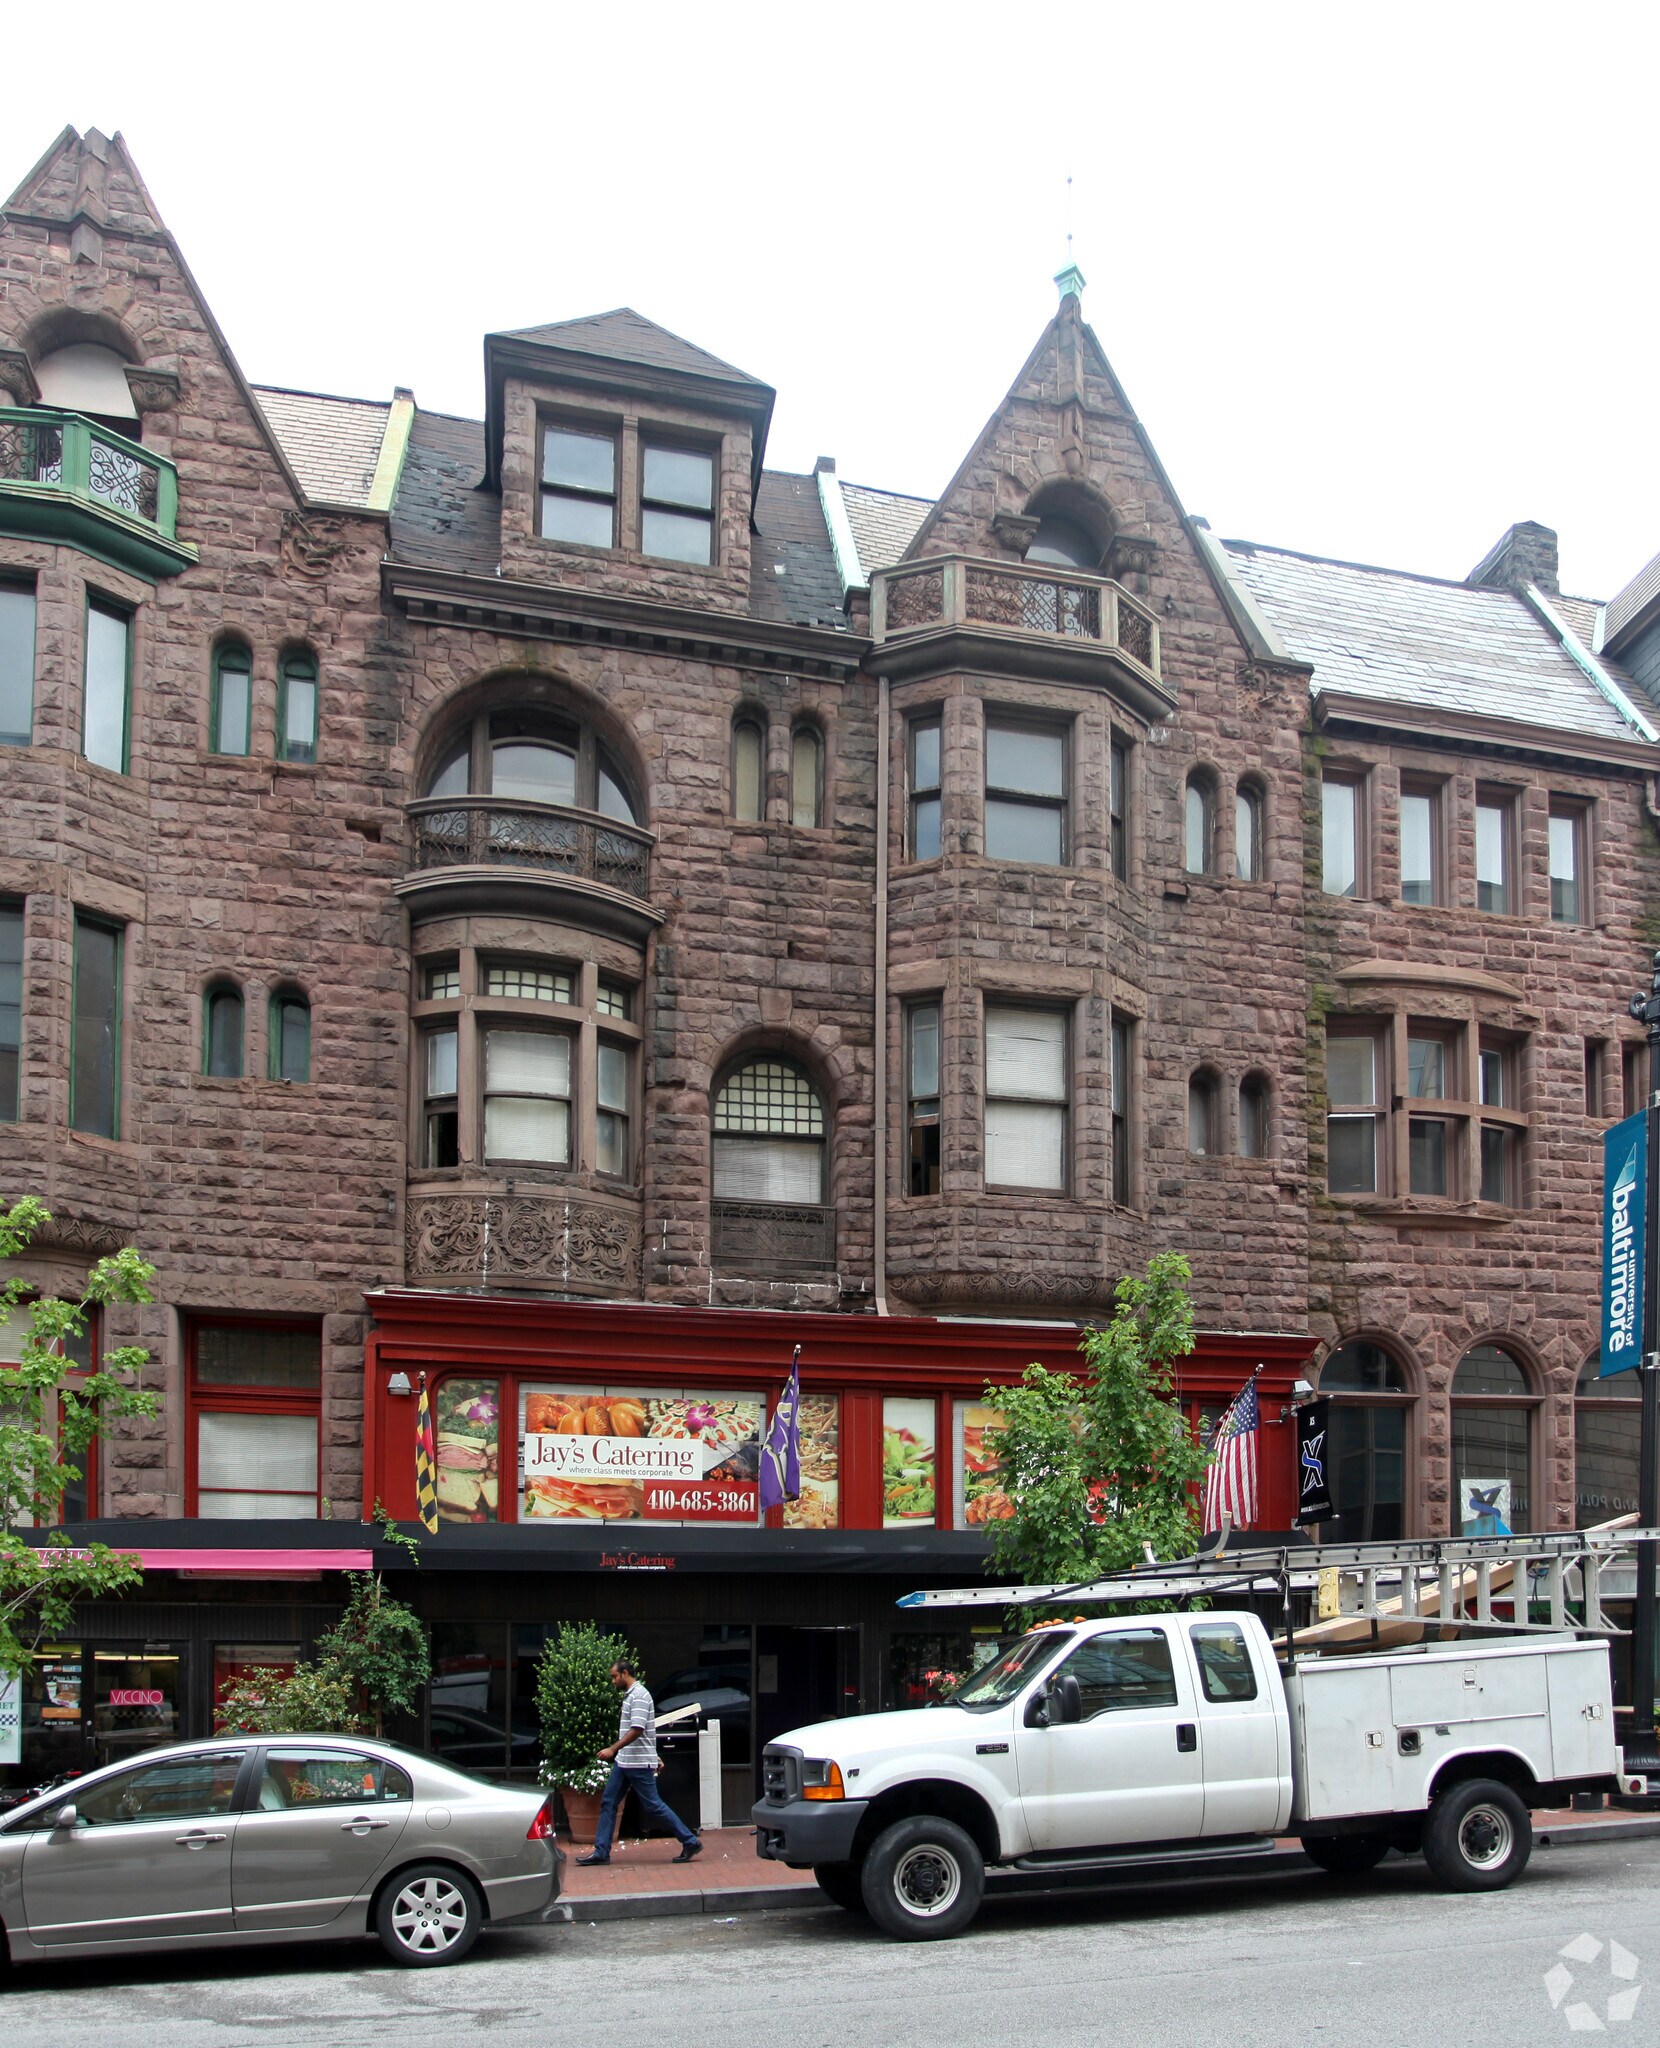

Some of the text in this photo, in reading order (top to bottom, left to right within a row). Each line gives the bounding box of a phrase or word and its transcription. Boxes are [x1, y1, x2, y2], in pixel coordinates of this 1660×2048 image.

[1609, 1181, 1636, 1353] baltimore
[1625, 1257, 1636, 1346] university of
[531, 1436, 694, 1475] Jay's Catering
[569, 1466, 673, 1477] where class meets corporate
[647, 1489, 755, 1512] 410-685-3861
[600, 1552, 676, 1569] Jay's Catering
[111, 1690, 163, 1704] VICCINO
